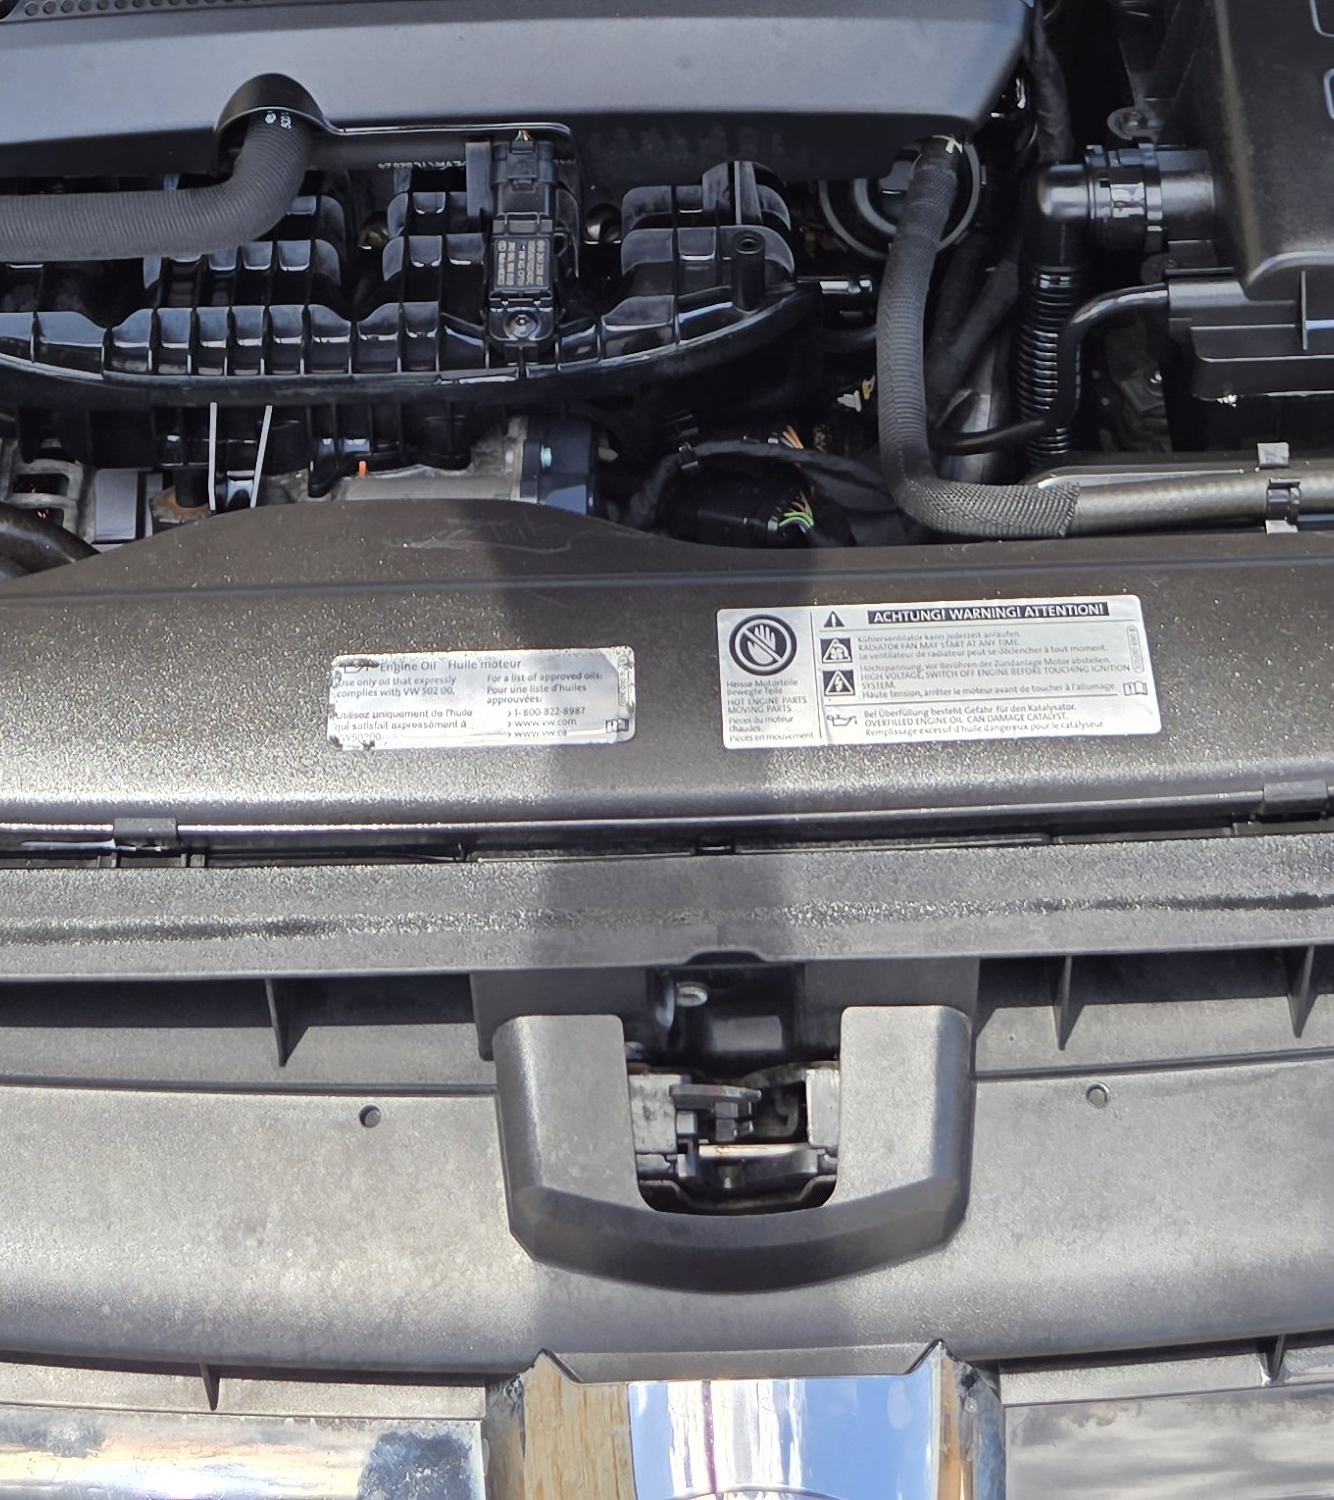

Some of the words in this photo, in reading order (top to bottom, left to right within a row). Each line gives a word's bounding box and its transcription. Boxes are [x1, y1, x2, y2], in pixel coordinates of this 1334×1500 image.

[873, 609, 945, 623] ACHTUNG!
[948, 606, 1021, 620] WARNING!
[1024, 604, 1105, 618] ATTENTION!
[857, 634, 922, 643] Kühlerventilator
[925, 633, 943, 641] kann
[946, 632, 982, 642] jederzeit
[858, 642, 899, 651] RADIATOR
[901, 642, 918, 650] FAN
[920, 641, 938, 649] MAY
[941, 640, 964, 648] START
[966, 640, 977, 648] AT
[979, 639, 996, 647] ANY
[998, 638, 1021, 646] TIME.
[869, 651, 914, 659] ventilateur
[916, 650, 926, 658] de
[928, 649, 965, 658] radiateur
[967, 649, 986, 658] peut
[1070, 644, 1107, 652] moment.
[380, 661, 417, 674] Engine
[420, 660, 436, 671] Oil
[447, 660, 478, 670] Huile
[480, 659, 522, 670] moteur
[979, 660, 992, 668] der
[994, 658, 1042, 668] Zündanlage
[1044, 657, 1069, 665] Motor
[1071, 656, 1111, 665] abstellen.
[487, 674, 501, 683] For
[511, 673, 525, 682] list
[527, 672, 537, 682] of
[539, 671, 582, 683] approved
[584, 671, 603, 680] oils:
[860, 672, 883, 681] HIGH
[926, 670, 958, 679] SWITCH
[960, 669, 975, 678] OFF
[977, 668, 1009, 677] ENGINE
[1011, 667, 1042, 676] BEFORE
[1044, 665, 1090, 674] TOUCHING
[1091, 664, 1131, 672] IGNITION
[356, 677, 377, 689] only
[378, 676, 391, 686] oil
[392, 675, 412, 685] that
[414, 674, 457, 687] expressly
[726, 680, 753, 688] Heisse
[755, 679, 798, 688] Motorteile
[861, 681, 895, 690] SYSTEM.
[335, 687, 378, 699] complies
[380, 686, 401, 697] with
[402, 686, 419, 697] VW
[421, 686, 438, 696] 502
[487, 685, 508, 695] Pour
[510, 685, 527, 693] une
[530, 683, 549, 693] liste
[551, 682, 587, 692] d'huiles
[726, 688, 763, 697] Bewegte
[764, 687, 783, 695] Teile
[862, 690, 887, 699] Haute
[924, 687, 952, 696] arrêter
[963, 686, 993, 695] moteur
[995, 685, 1018, 693] avant
[1019, 684, 1030, 692] de
[1031, 683, 1063, 692] toucher
[487, 695, 543, 707] approuvées:
[727, 697, 745, 706] HOT
[748, 697, 779, 705] ENGINE
[782, 696, 808, 704] PARTS
[371, 709, 429, 722] uniquement
[431, 708, 443, 718] de
[446, 707, 473, 718] l'huile
[728, 705, 764, 714] MOVING
[766, 705, 792, 713] PARTS
[879, 707, 929, 718] Überfüllung
[931, 706, 962, 715] besteht
[964, 705, 992, 714] Gefahr
[996, 703, 1009, 712] für
[1010, 703, 1027, 712] den
[1028, 703, 1077, 713] Katalysator.
[334, 721, 350, 732] qui
[351, 719, 388, 730] satisfait
[391, 718, 458, 732] expressément
[729, 715, 754, 724] Pièces
[766, 714, 794, 723] moteur
[864, 718, 914, 728] OVERFILLED
[916, 717, 947, 726] ENGINE
[949, 716, 963, 724] OIL
[967, 715, 986, 724] CAN
[987, 713, 1025, 723] DAMAGE
[865, 727, 917, 737] Remplissage
[919, 726, 952, 735] excessif
[955, 725, 982, 733] d'huile
[984, 723, 1028, 733] dangereux
[1030, 723, 1050, 732] pour
[729, 734, 753, 743] Pièces
